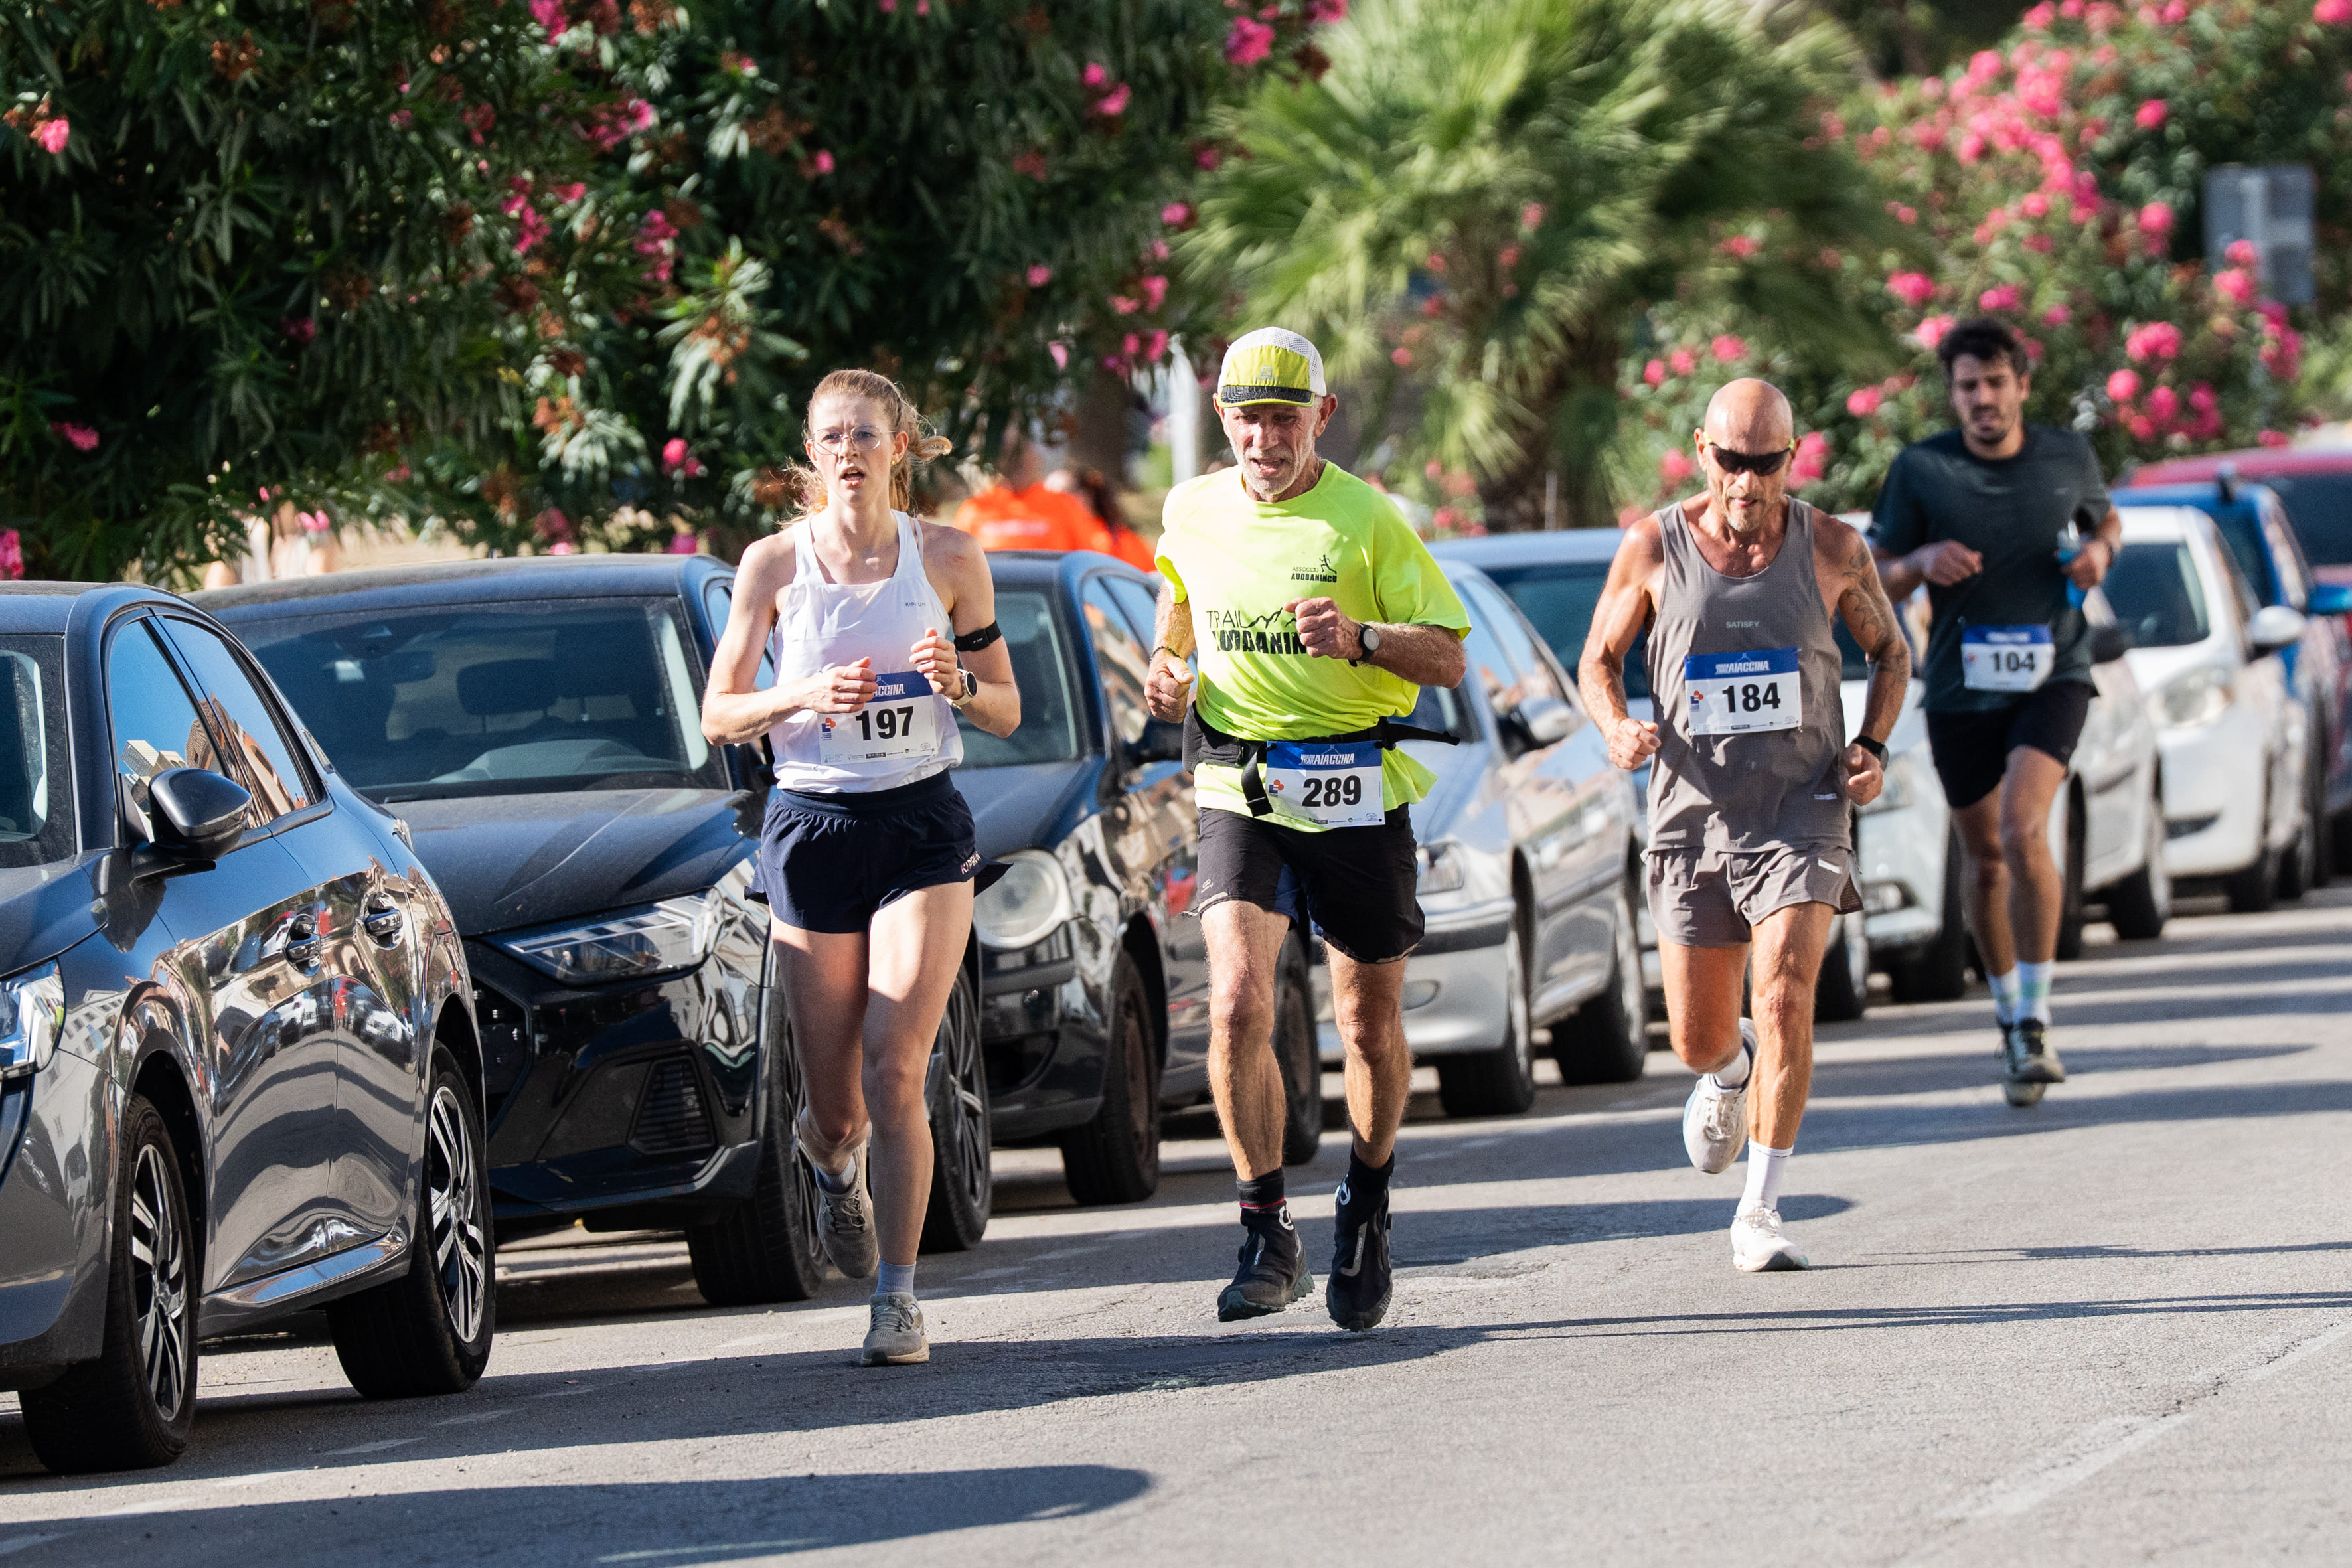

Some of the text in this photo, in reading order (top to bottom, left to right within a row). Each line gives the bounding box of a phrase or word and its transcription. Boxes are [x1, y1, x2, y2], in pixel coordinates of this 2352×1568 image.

[1206, 610, 1248, 629] TRAIL
[1727, 661, 1769, 673] AIACCINA
[1991, 651, 2035, 672] 104
[1722, 682, 1780, 713] 184
[855, 706, 913, 741] 197
[1314, 753, 1355, 765] AIACCINA
[1302, 775, 1362, 807] 289
[961, 850, 981, 874] KIPRUN
